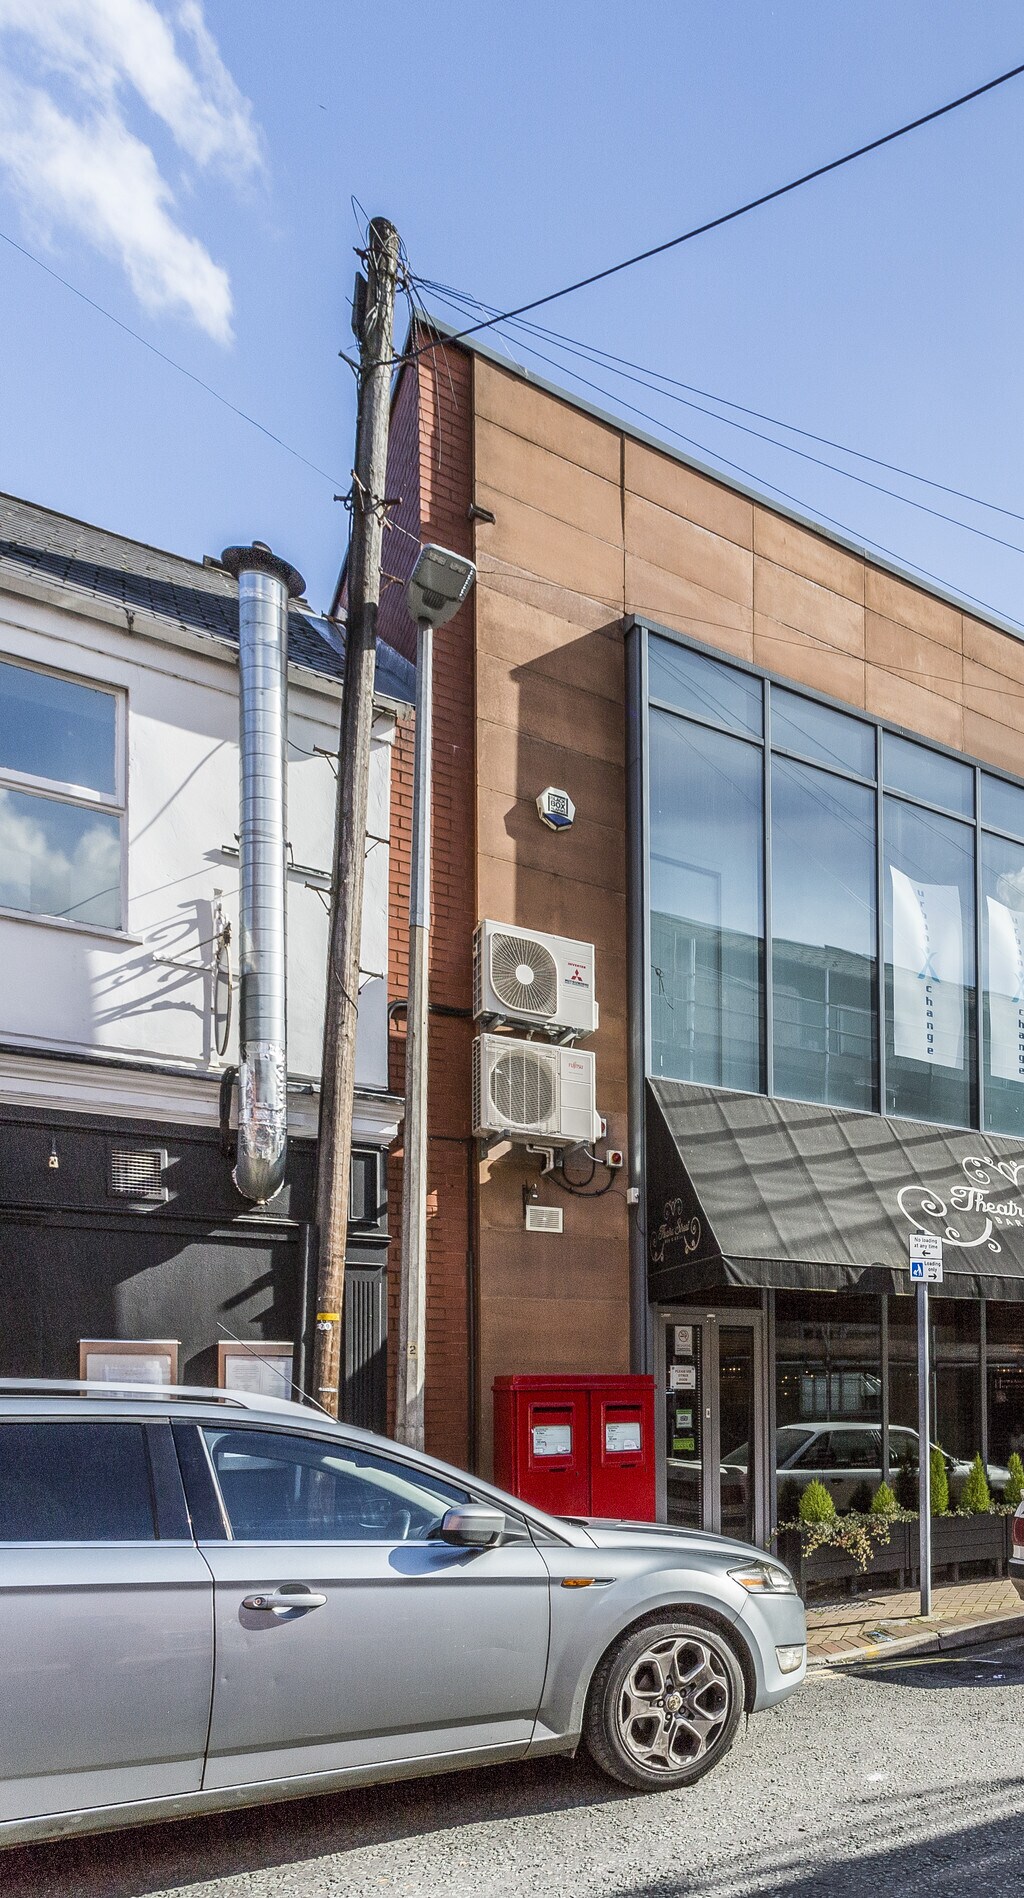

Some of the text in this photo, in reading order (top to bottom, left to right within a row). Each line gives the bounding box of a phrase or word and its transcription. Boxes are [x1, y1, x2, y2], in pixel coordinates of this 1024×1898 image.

[551, 800, 566, 811] BOX
[994, 1216, 1024, 1228] BAR
[409, 1345, 416, 1355] 2
